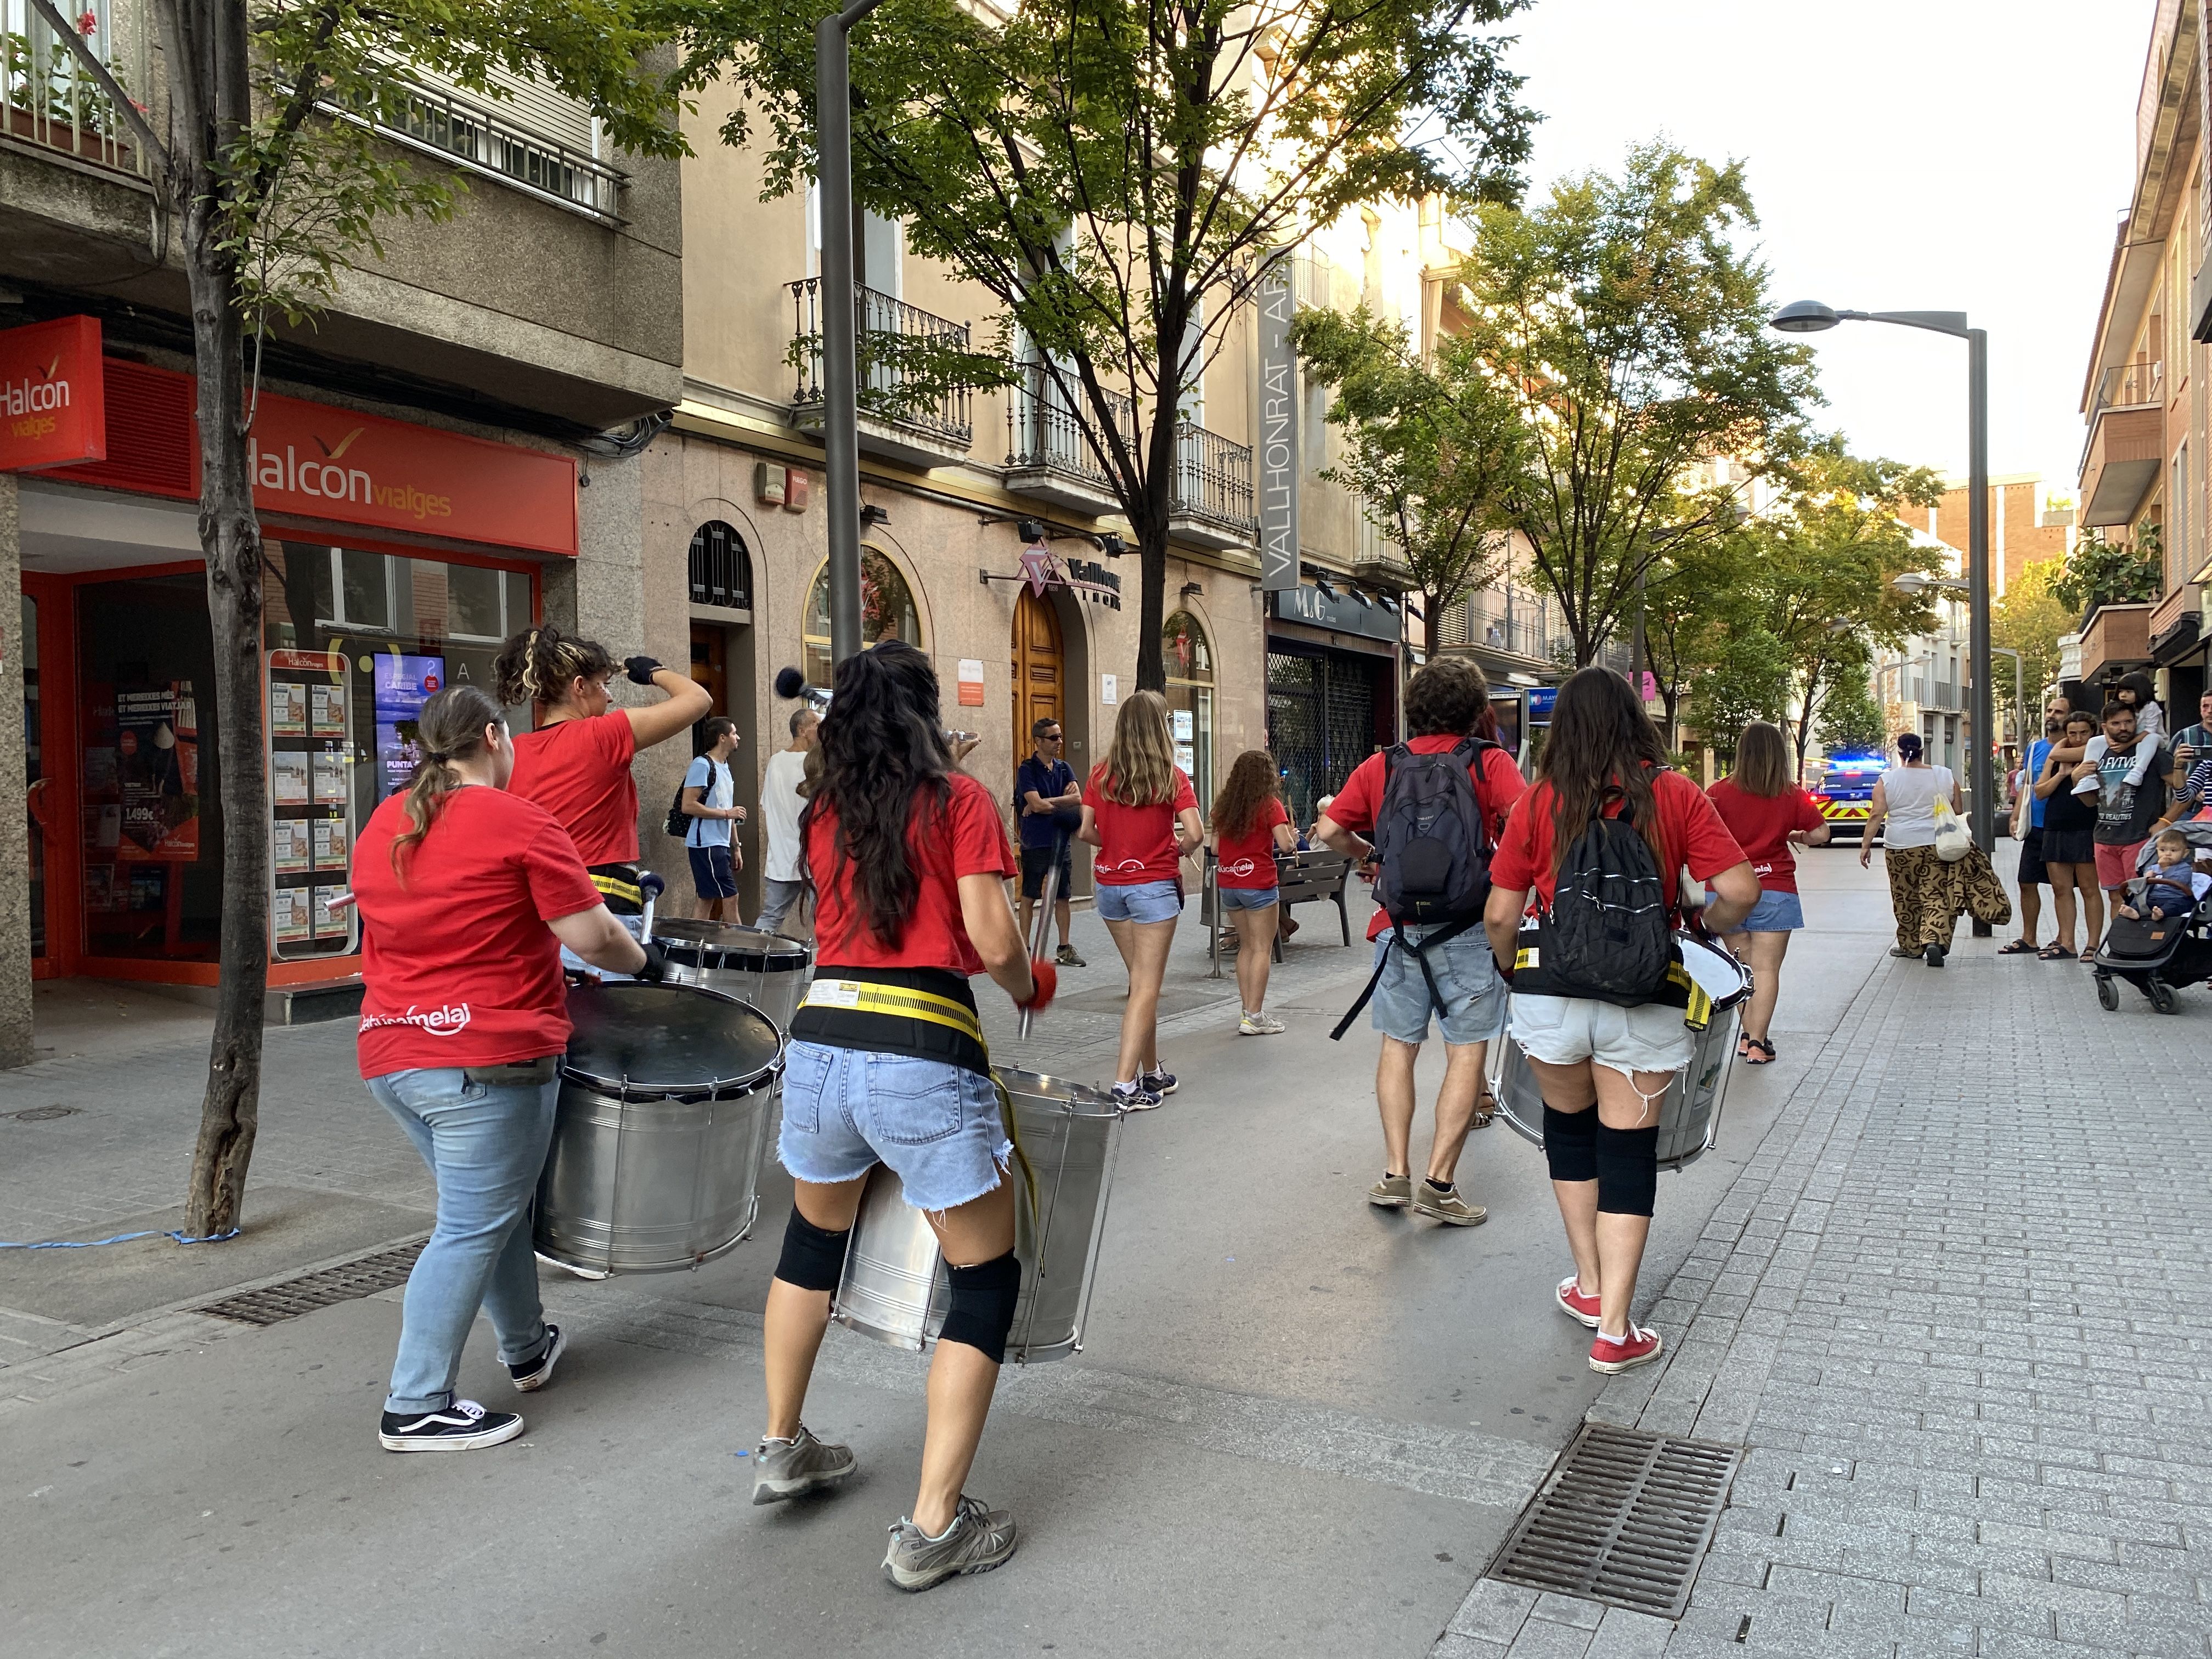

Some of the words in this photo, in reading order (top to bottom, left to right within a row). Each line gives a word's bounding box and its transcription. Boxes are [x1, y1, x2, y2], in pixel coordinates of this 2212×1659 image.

[1265, 358, 1291, 578] VALLHONRAT
[792, 476, 807, 486] FUEGO
[373, 484, 452, 519] viatges
[385, 681, 417, 690] CARIBE
[161, 700, 191, 711] VIATJAR
